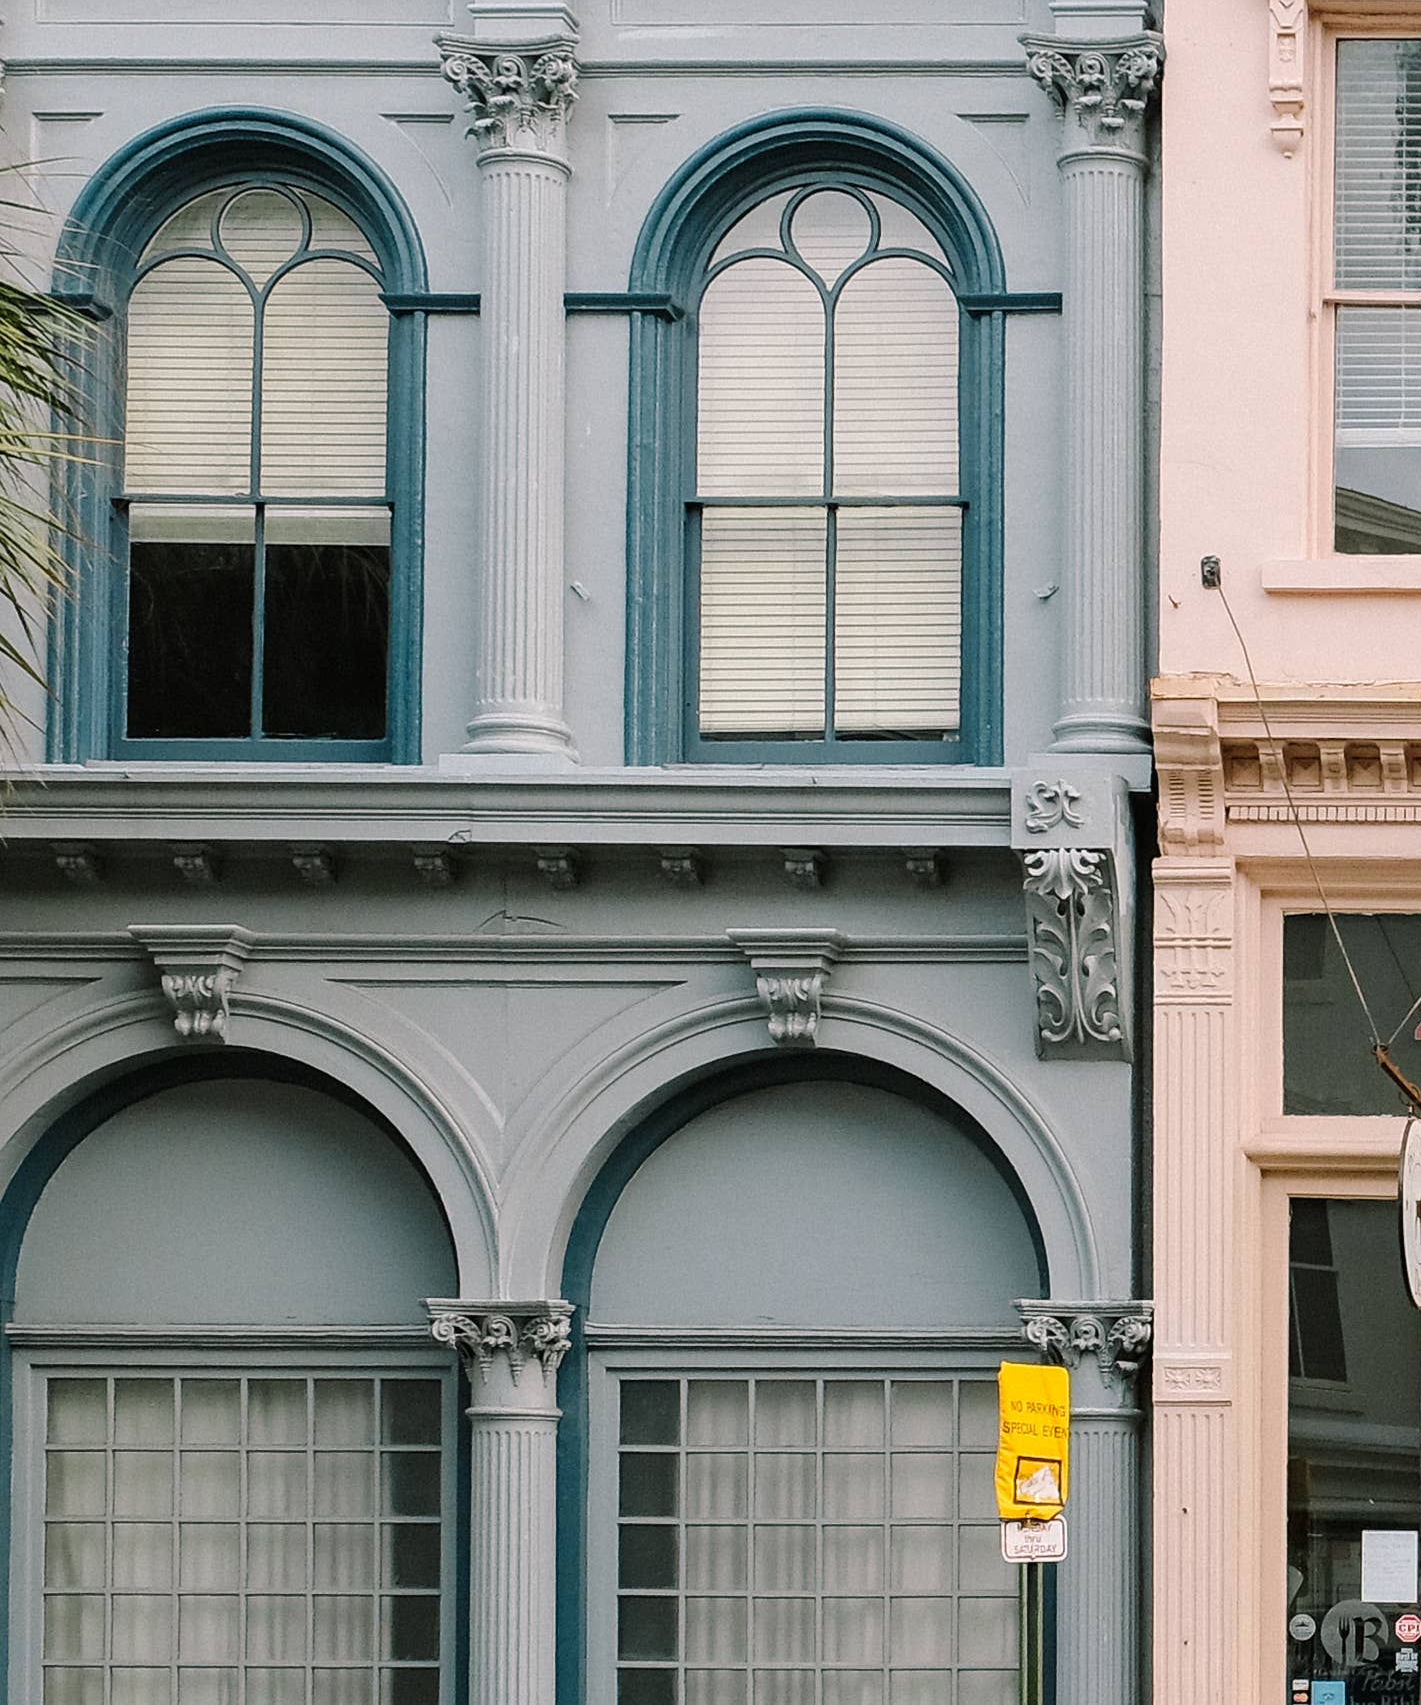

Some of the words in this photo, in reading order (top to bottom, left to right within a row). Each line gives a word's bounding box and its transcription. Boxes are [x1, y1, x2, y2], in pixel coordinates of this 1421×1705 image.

[1011, 1401, 1023, 1413] NO
[1026, 1401, 1066, 1417] PARKING
[1002, 1421, 1039, 1437] SPECIAL
[1016, 1523, 1053, 1533] MDAY
[1014, 1544, 1057, 1555] SATURDAY
[1398, 1624, 1420, 1633] CPI
